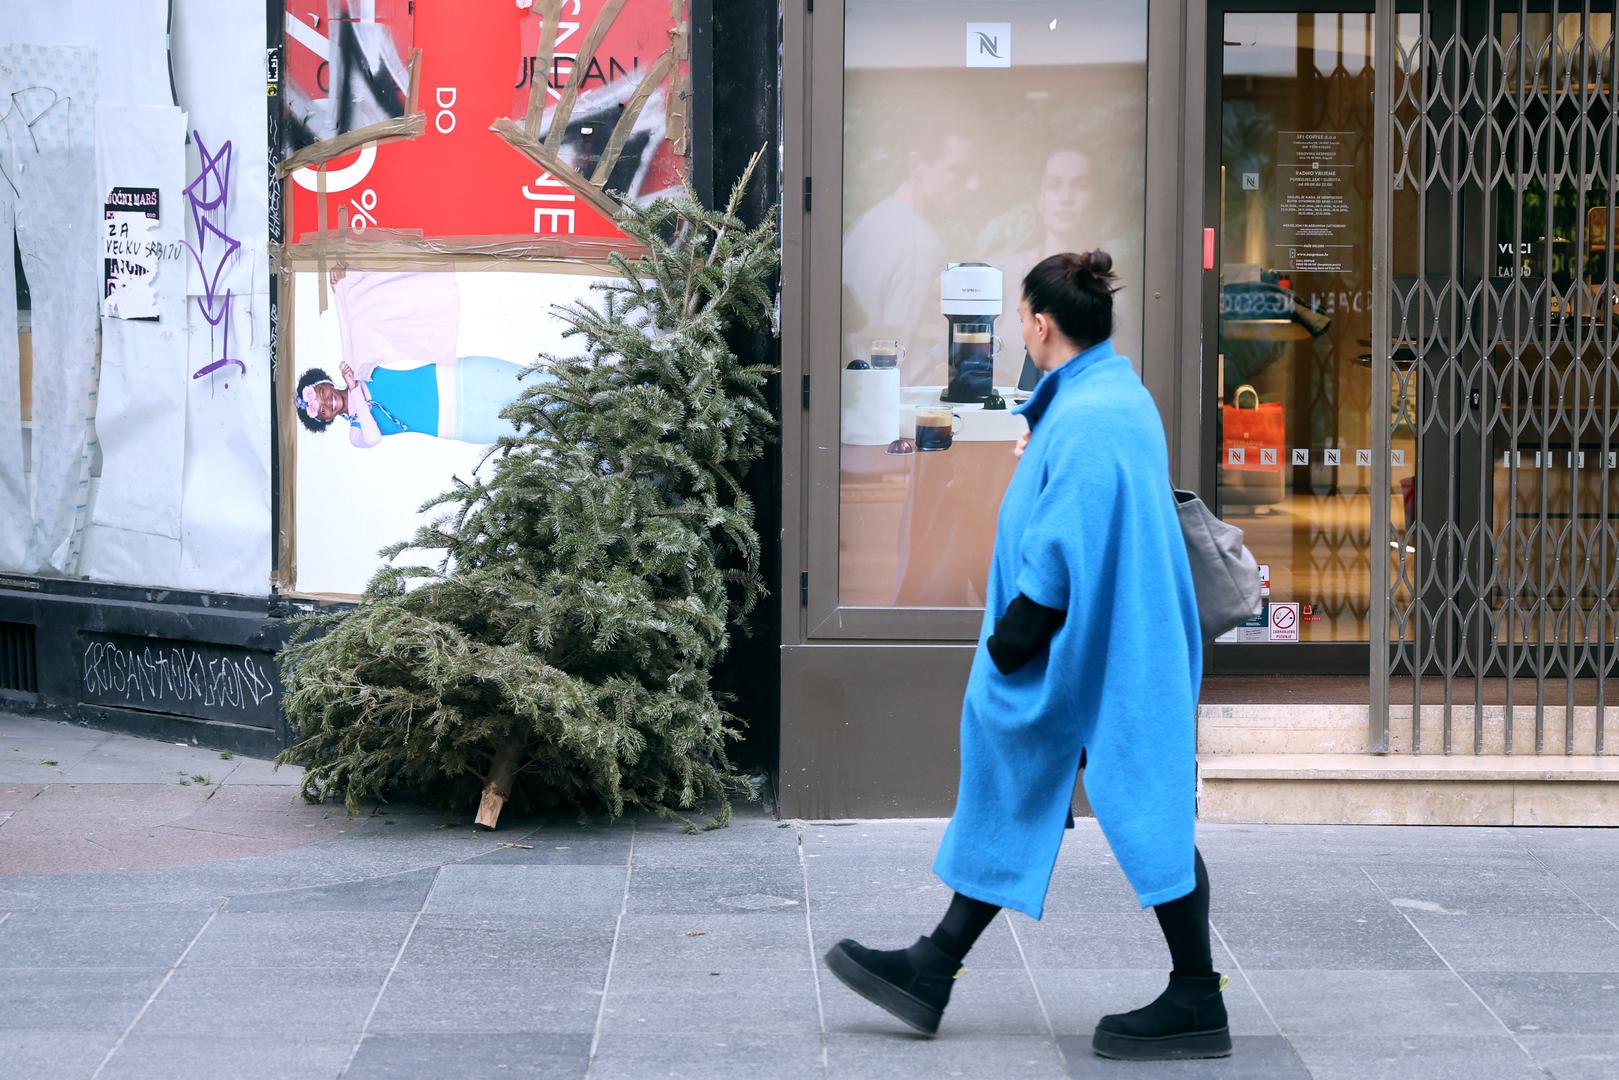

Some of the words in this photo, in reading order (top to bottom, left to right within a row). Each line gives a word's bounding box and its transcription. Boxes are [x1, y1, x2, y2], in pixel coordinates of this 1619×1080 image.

[435, 87, 457, 134] DO
[133, 191, 157, 206] MARŠ
[351, 189, 377, 234] %
[109, 223, 129, 238] ZA
